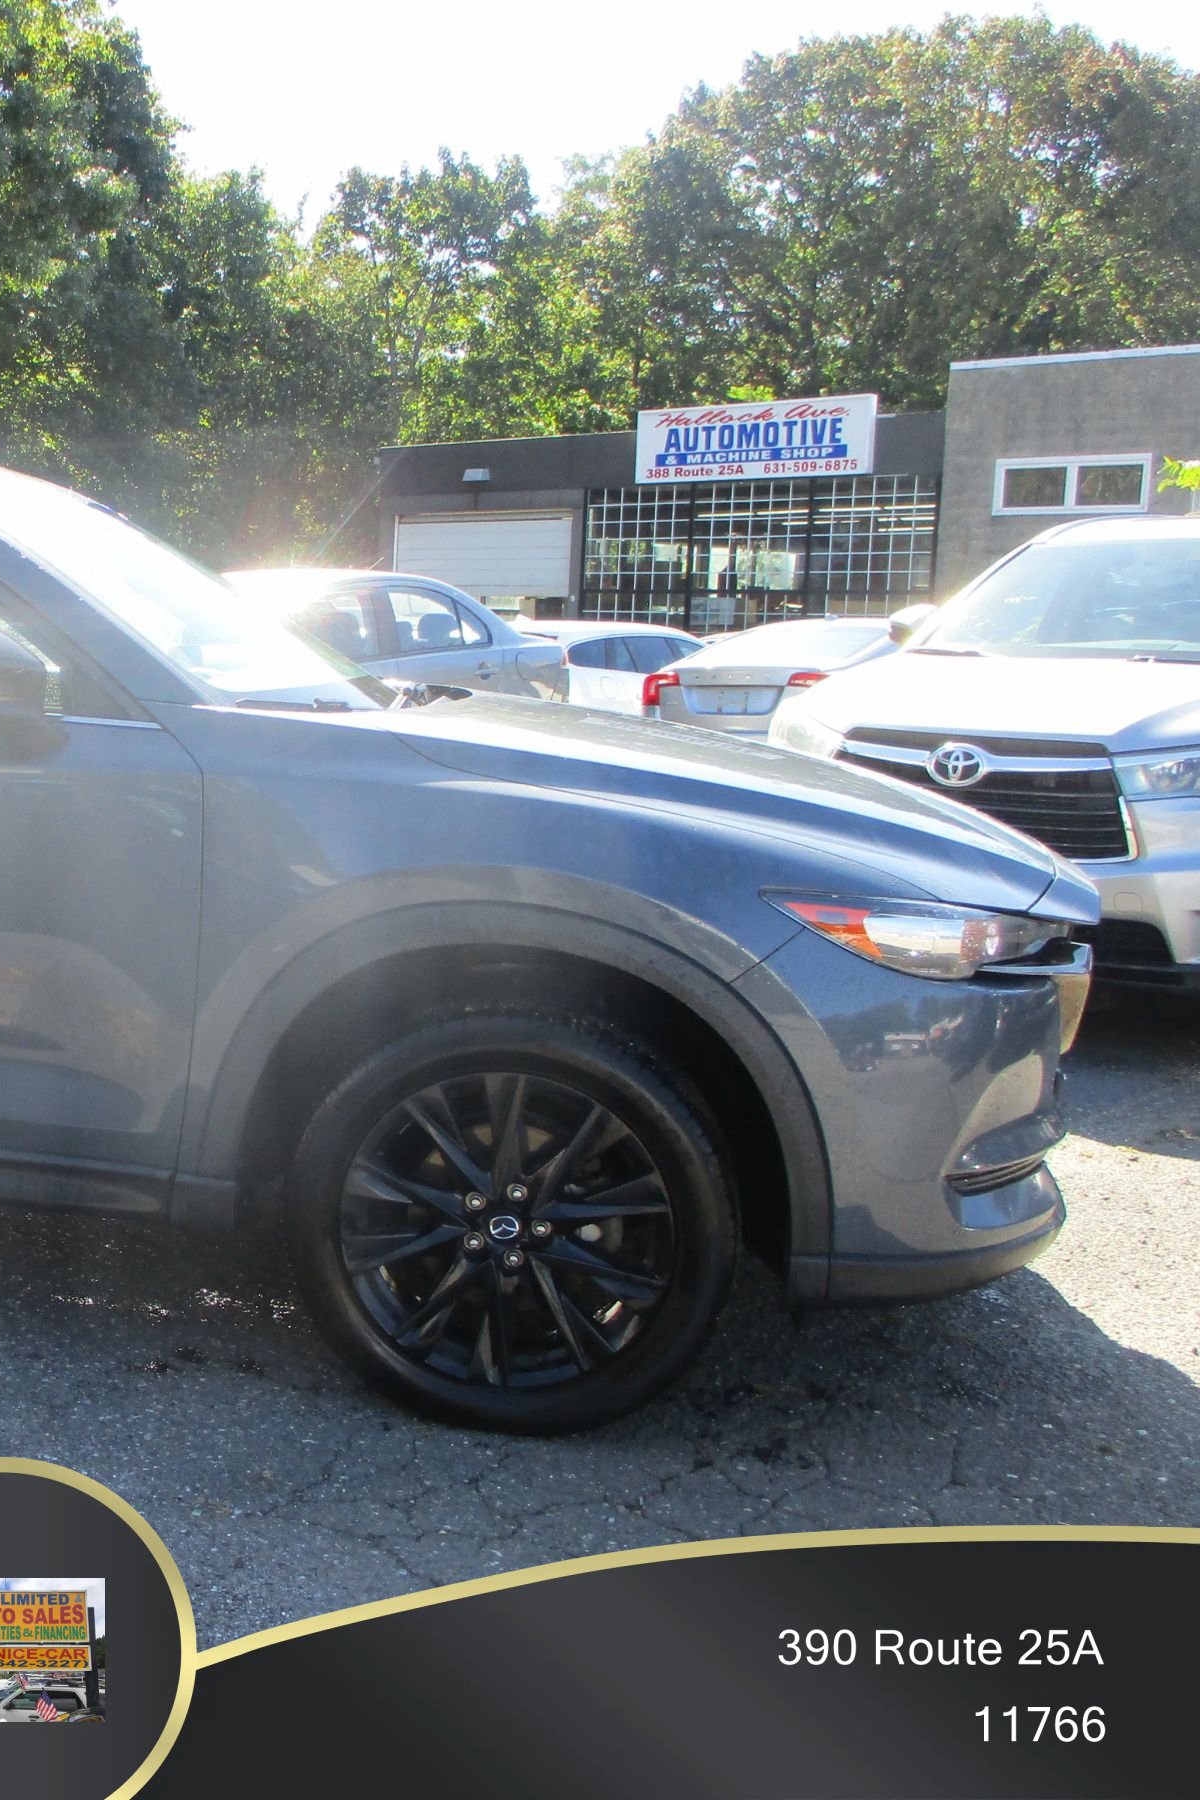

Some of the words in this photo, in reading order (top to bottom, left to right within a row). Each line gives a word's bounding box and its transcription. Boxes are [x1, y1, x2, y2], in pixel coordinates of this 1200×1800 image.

[654, 407, 775, 429] Hallock
[784, 403, 851, 419] Ave.
[664, 417, 843, 453] AUTOMOTIVE
[665, 455, 678, 466] &
[686, 450, 771, 465] MACHINE
[780, 446, 834, 460] SHOP
[646, 468, 670, 479] 388
[674, 466, 714, 478] Route
[718, 465, 745, 476] 25A
[763, 459, 858, 474] 631-509-6875
